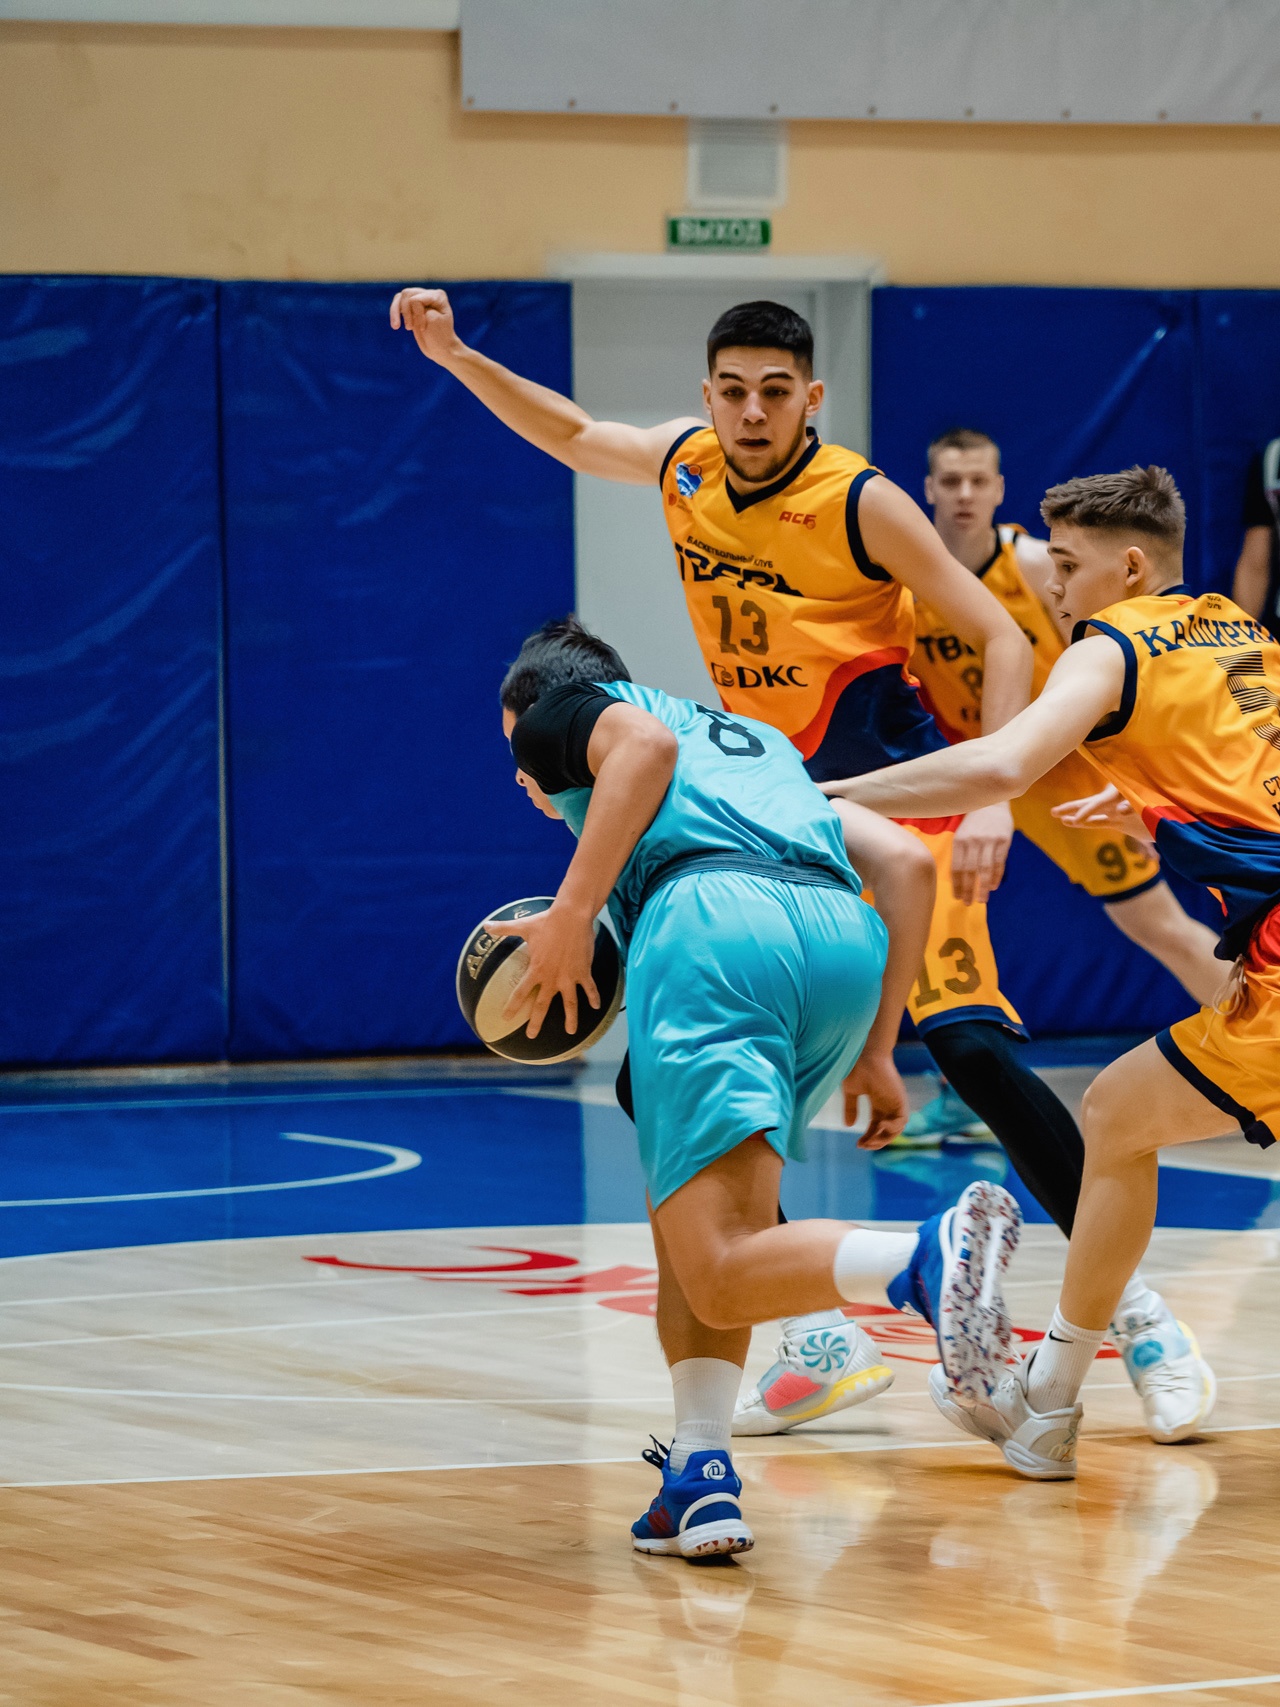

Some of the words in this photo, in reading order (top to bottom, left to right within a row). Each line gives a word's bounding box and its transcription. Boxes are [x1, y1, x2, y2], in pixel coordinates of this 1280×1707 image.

[679, 218, 761, 243] ВЫХОД
[711, 595, 770, 656] 13
[1133, 614, 1277, 658] КАШИРИ
[736, 664, 809, 689] DKC
[694, 702, 767, 758] 8
